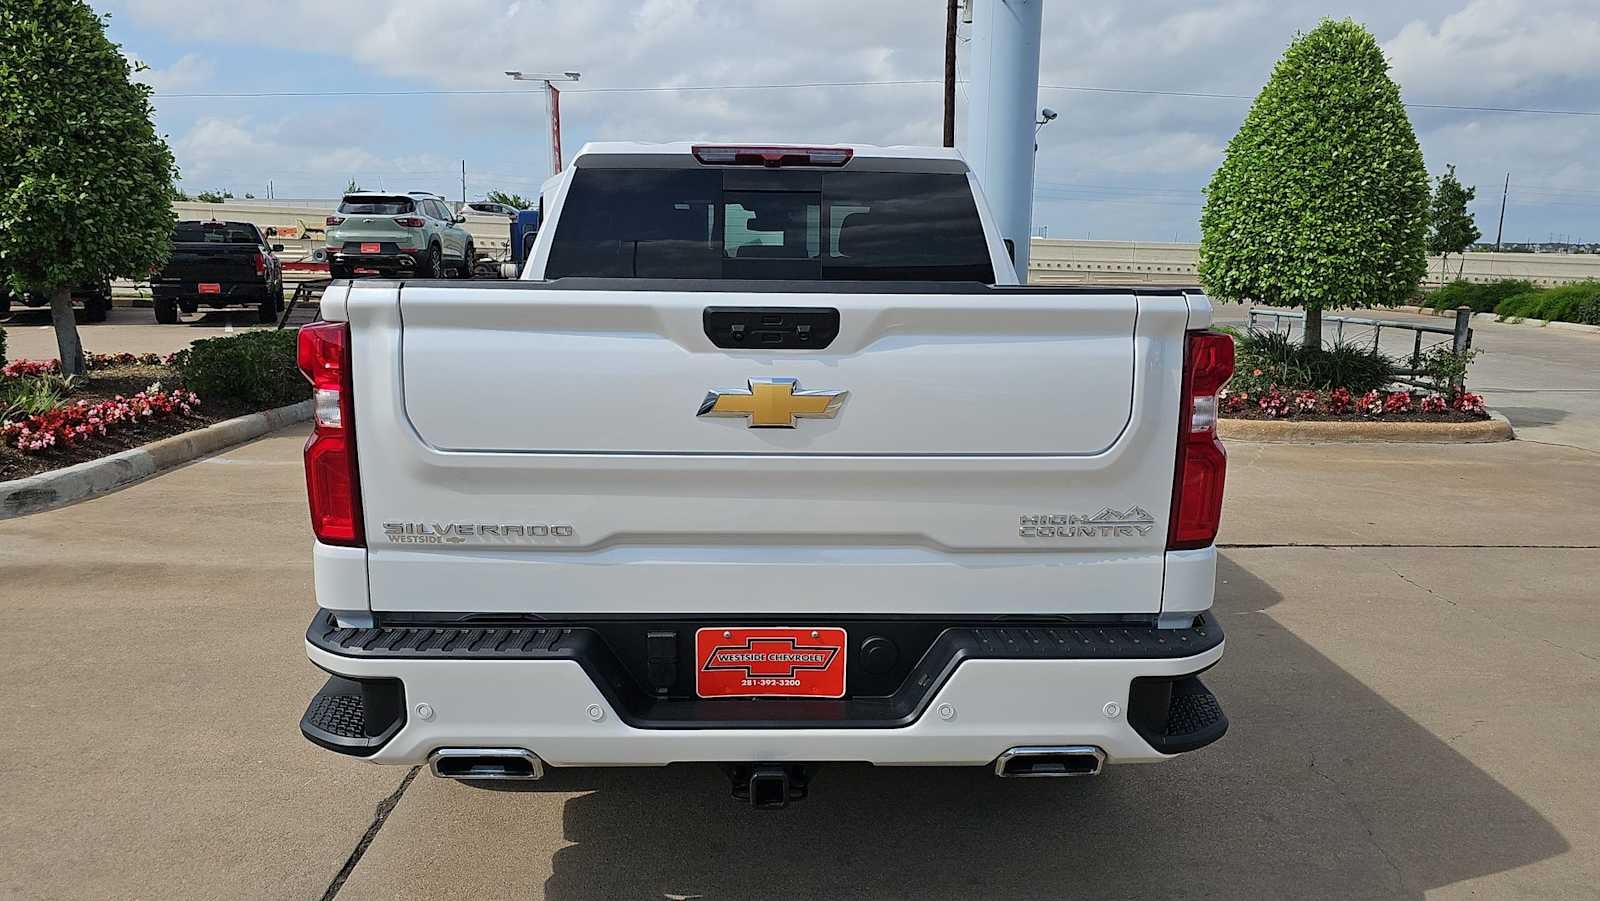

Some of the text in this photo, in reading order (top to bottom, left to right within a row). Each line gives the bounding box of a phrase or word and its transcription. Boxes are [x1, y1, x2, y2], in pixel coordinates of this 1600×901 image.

[1019, 514, 1088, 525] HIGH
[383, 521, 574, 537] SILVERADO
[1018, 525, 1153, 537] COUNTRY
[388, 535, 443, 544] WESTSIDE
[717, 653, 825, 662] WESTSIDE CHEVROLET
